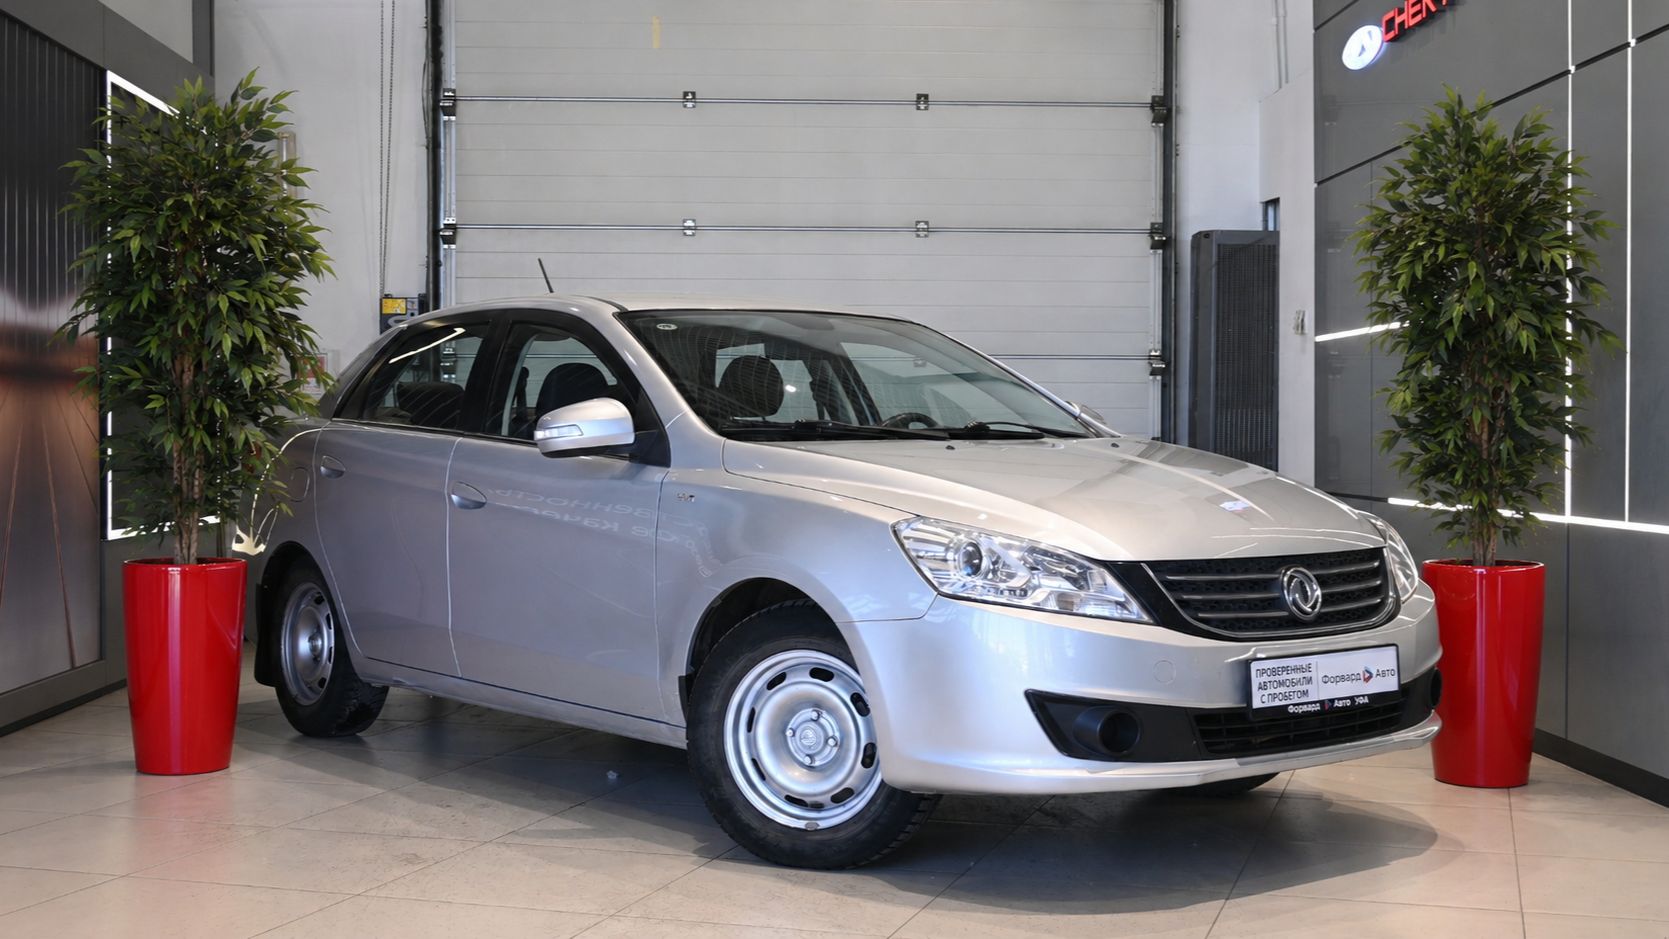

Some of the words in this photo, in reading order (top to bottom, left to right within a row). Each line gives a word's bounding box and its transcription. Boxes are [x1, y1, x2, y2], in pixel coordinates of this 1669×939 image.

[1382, 0, 1447, 42] CHER
[1256, 663, 1312, 678] ПРОВЕРЕННЫЕ
[1321, 672, 1361, 685] Форвард
[1375, 668, 1395, 678] Авто
[1257, 676, 1313, 692] АВТОМОБИЛИ
[1260, 694, 1266, 704] С
[1267, 689, 1309, 703] ПРОБЕГОМ
[1287, 702, 1321, 714] Форвард
[1333, 698, 1352, 708] Авто
